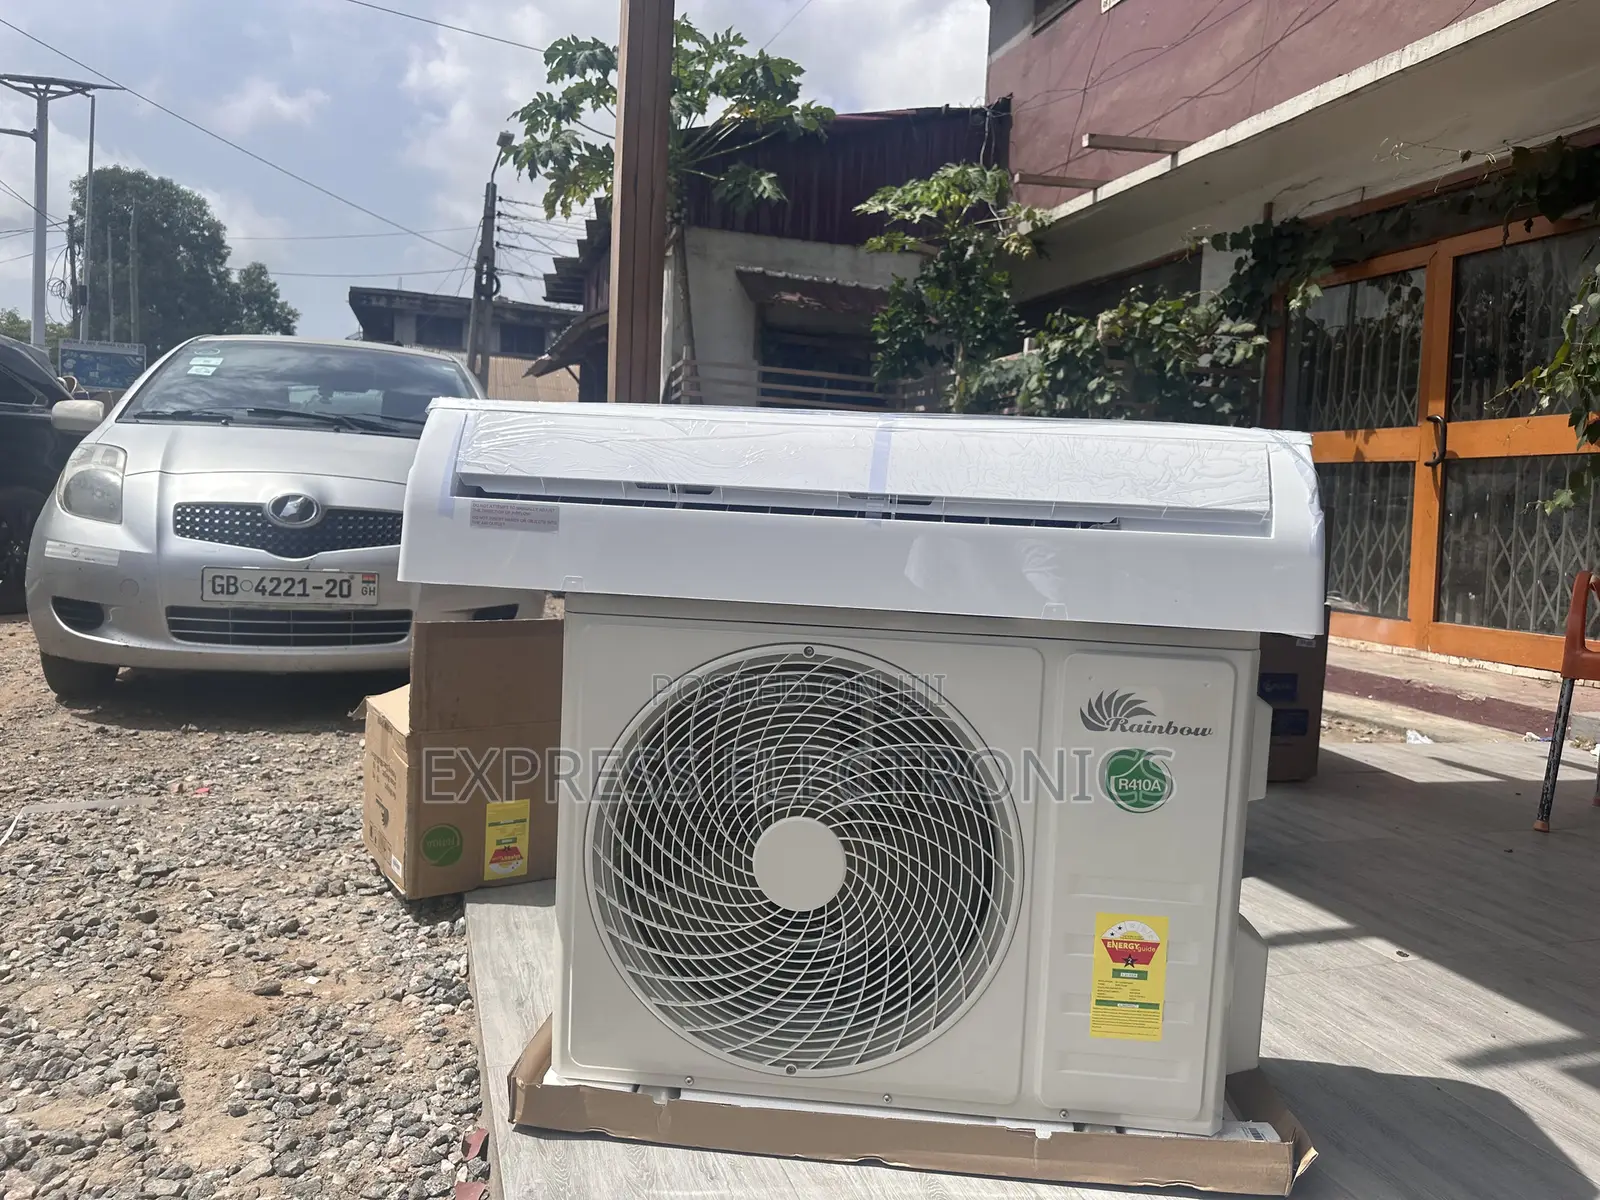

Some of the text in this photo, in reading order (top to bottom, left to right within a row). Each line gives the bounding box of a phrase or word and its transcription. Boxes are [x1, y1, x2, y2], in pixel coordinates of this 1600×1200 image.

[211, 575, 352, 598] GB 4221-20
[361, 586, 376, 596] GH
[1105, 718, 1213, 737] Rainbow
[1118, 778, 1162, 791] R410A
[1106, 940, 1156, 953] ENERGY guide
